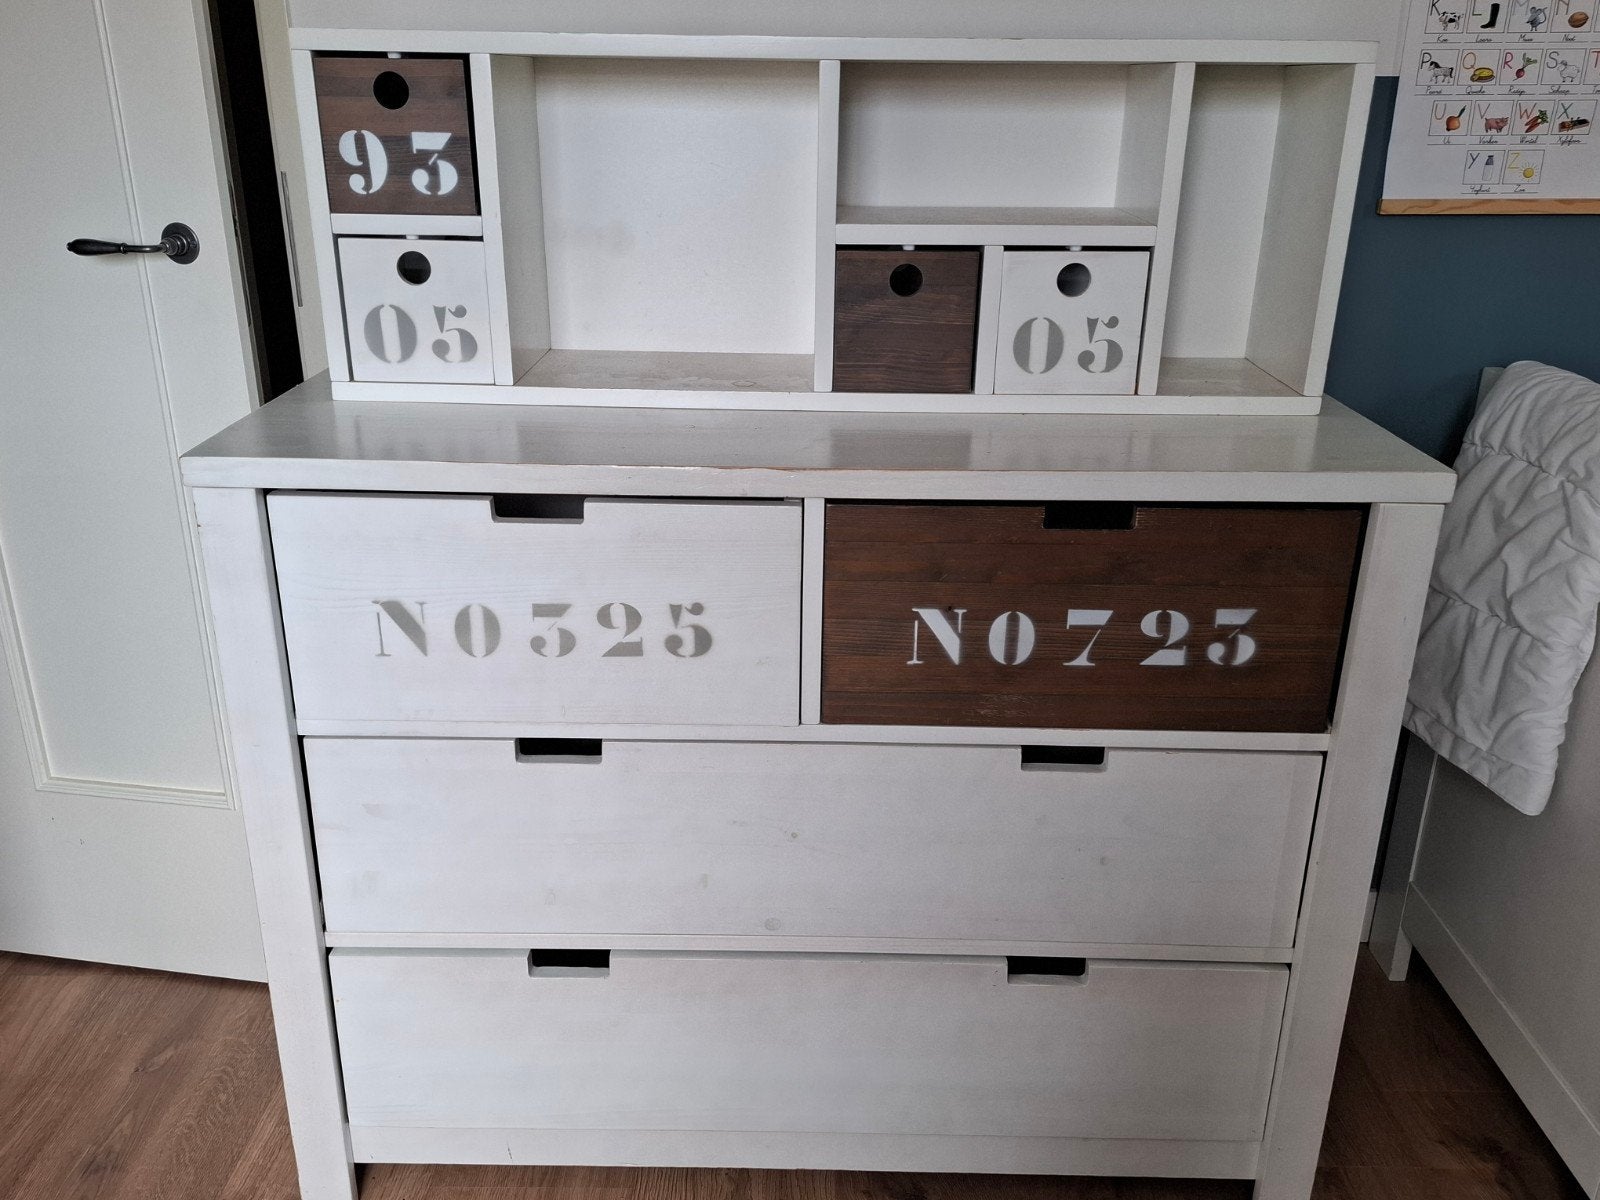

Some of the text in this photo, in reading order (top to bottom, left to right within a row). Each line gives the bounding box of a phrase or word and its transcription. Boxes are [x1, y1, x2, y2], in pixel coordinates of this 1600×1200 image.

[1429, 0, 1441, 16] K
[1471, 0, 1482, 16] L
[1511, 0, 1530, 16] M
[1555, 0, 1570, 16] N
[1420, 52, 1432, 70] P
[1462, 52, 1477, 70] Q
[1503, 52, 1513, 70] R
[1546, 51, 1559, 69] S
[1434, 103, 1446, 121] U
[1477, 103, 1490, 120] V
[1518, 102, 1537, 120] W
[1556, 102, 1573, 120] X
[338, 129, 459, 195] 93
[1468, 152, 1480, 169] Y
[1507, 152, 1520, 169] Z
[363, 303, 478, 364] 05
[1012, 315, 1124, 375] 05
